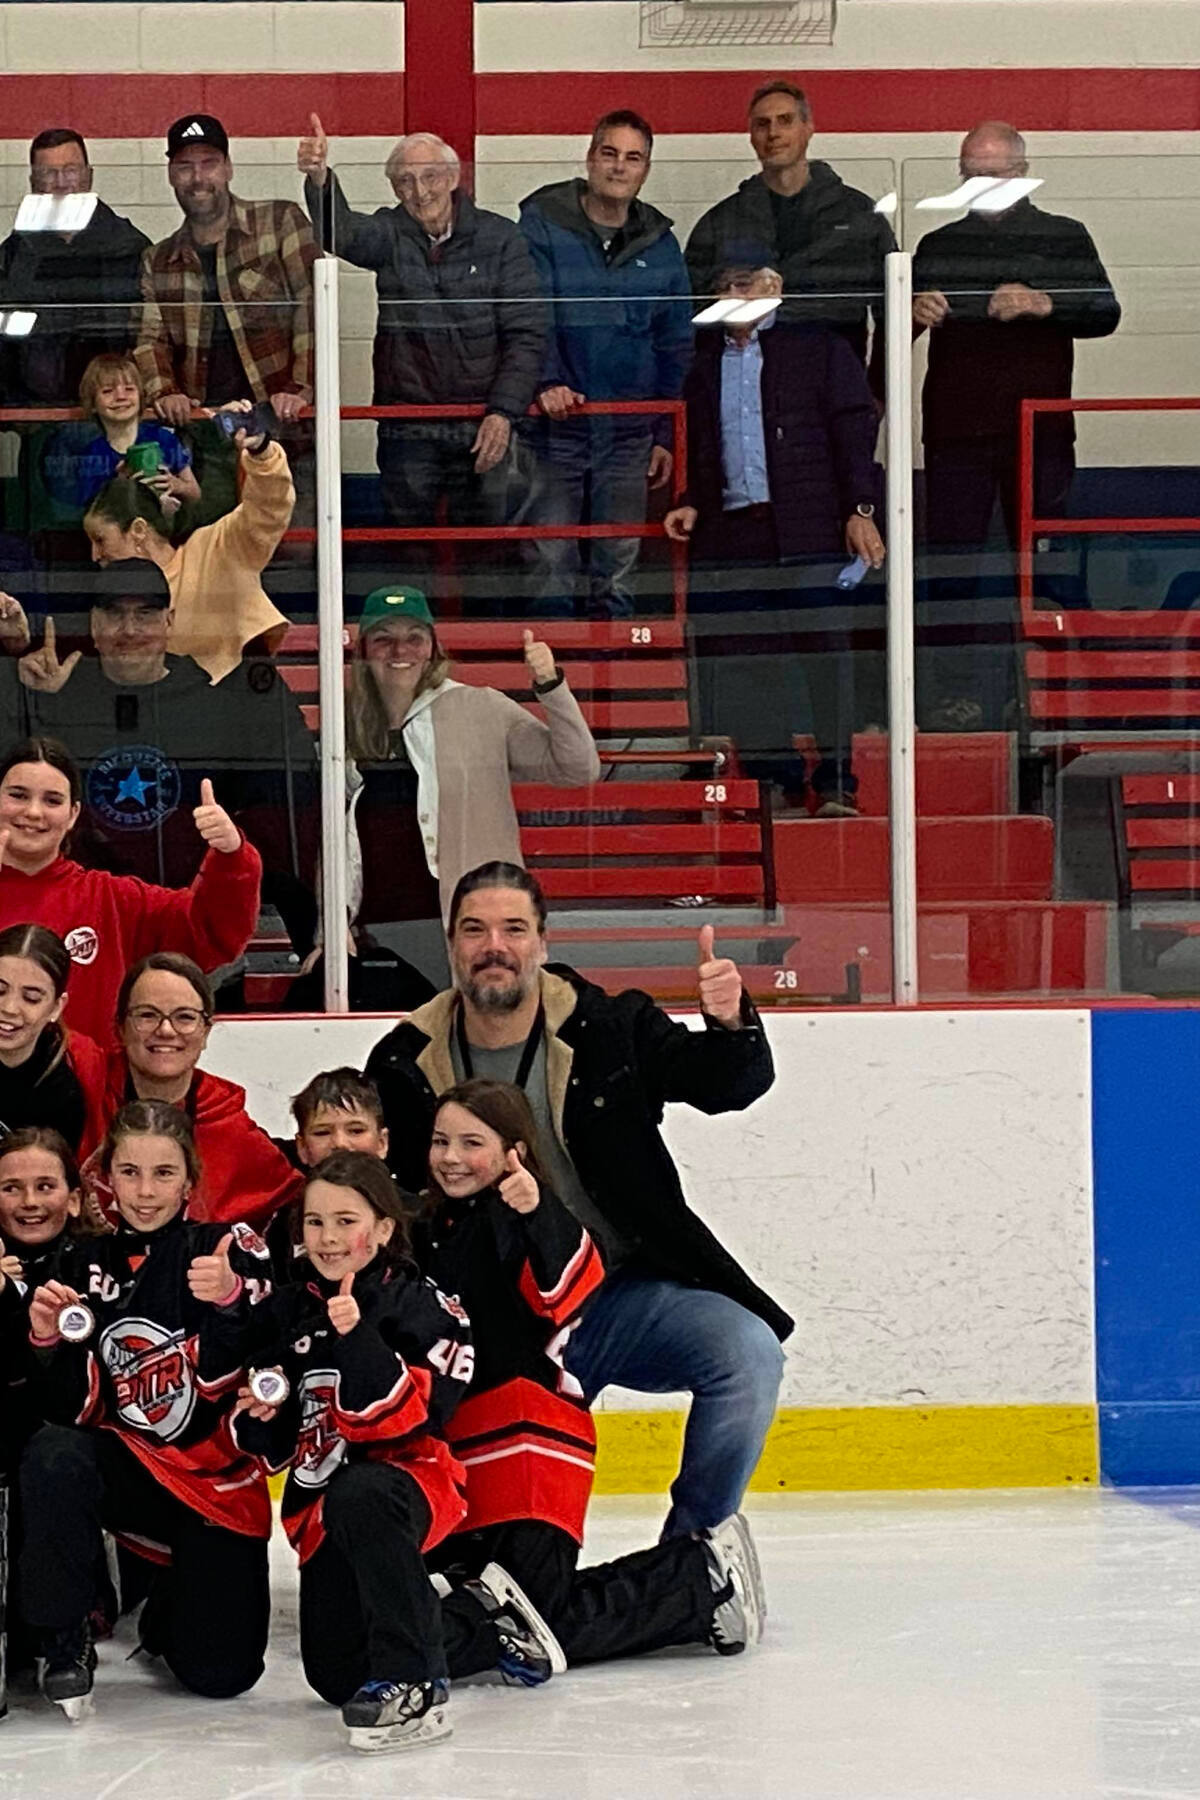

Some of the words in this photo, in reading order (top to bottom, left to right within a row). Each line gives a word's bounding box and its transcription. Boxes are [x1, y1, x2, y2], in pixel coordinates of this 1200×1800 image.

[630, 627, 652, 644] 28
[704, 785, 727, 802] 28
[774, 970, 797, 988] 28
[426, 1337, 476, 1385] 46
